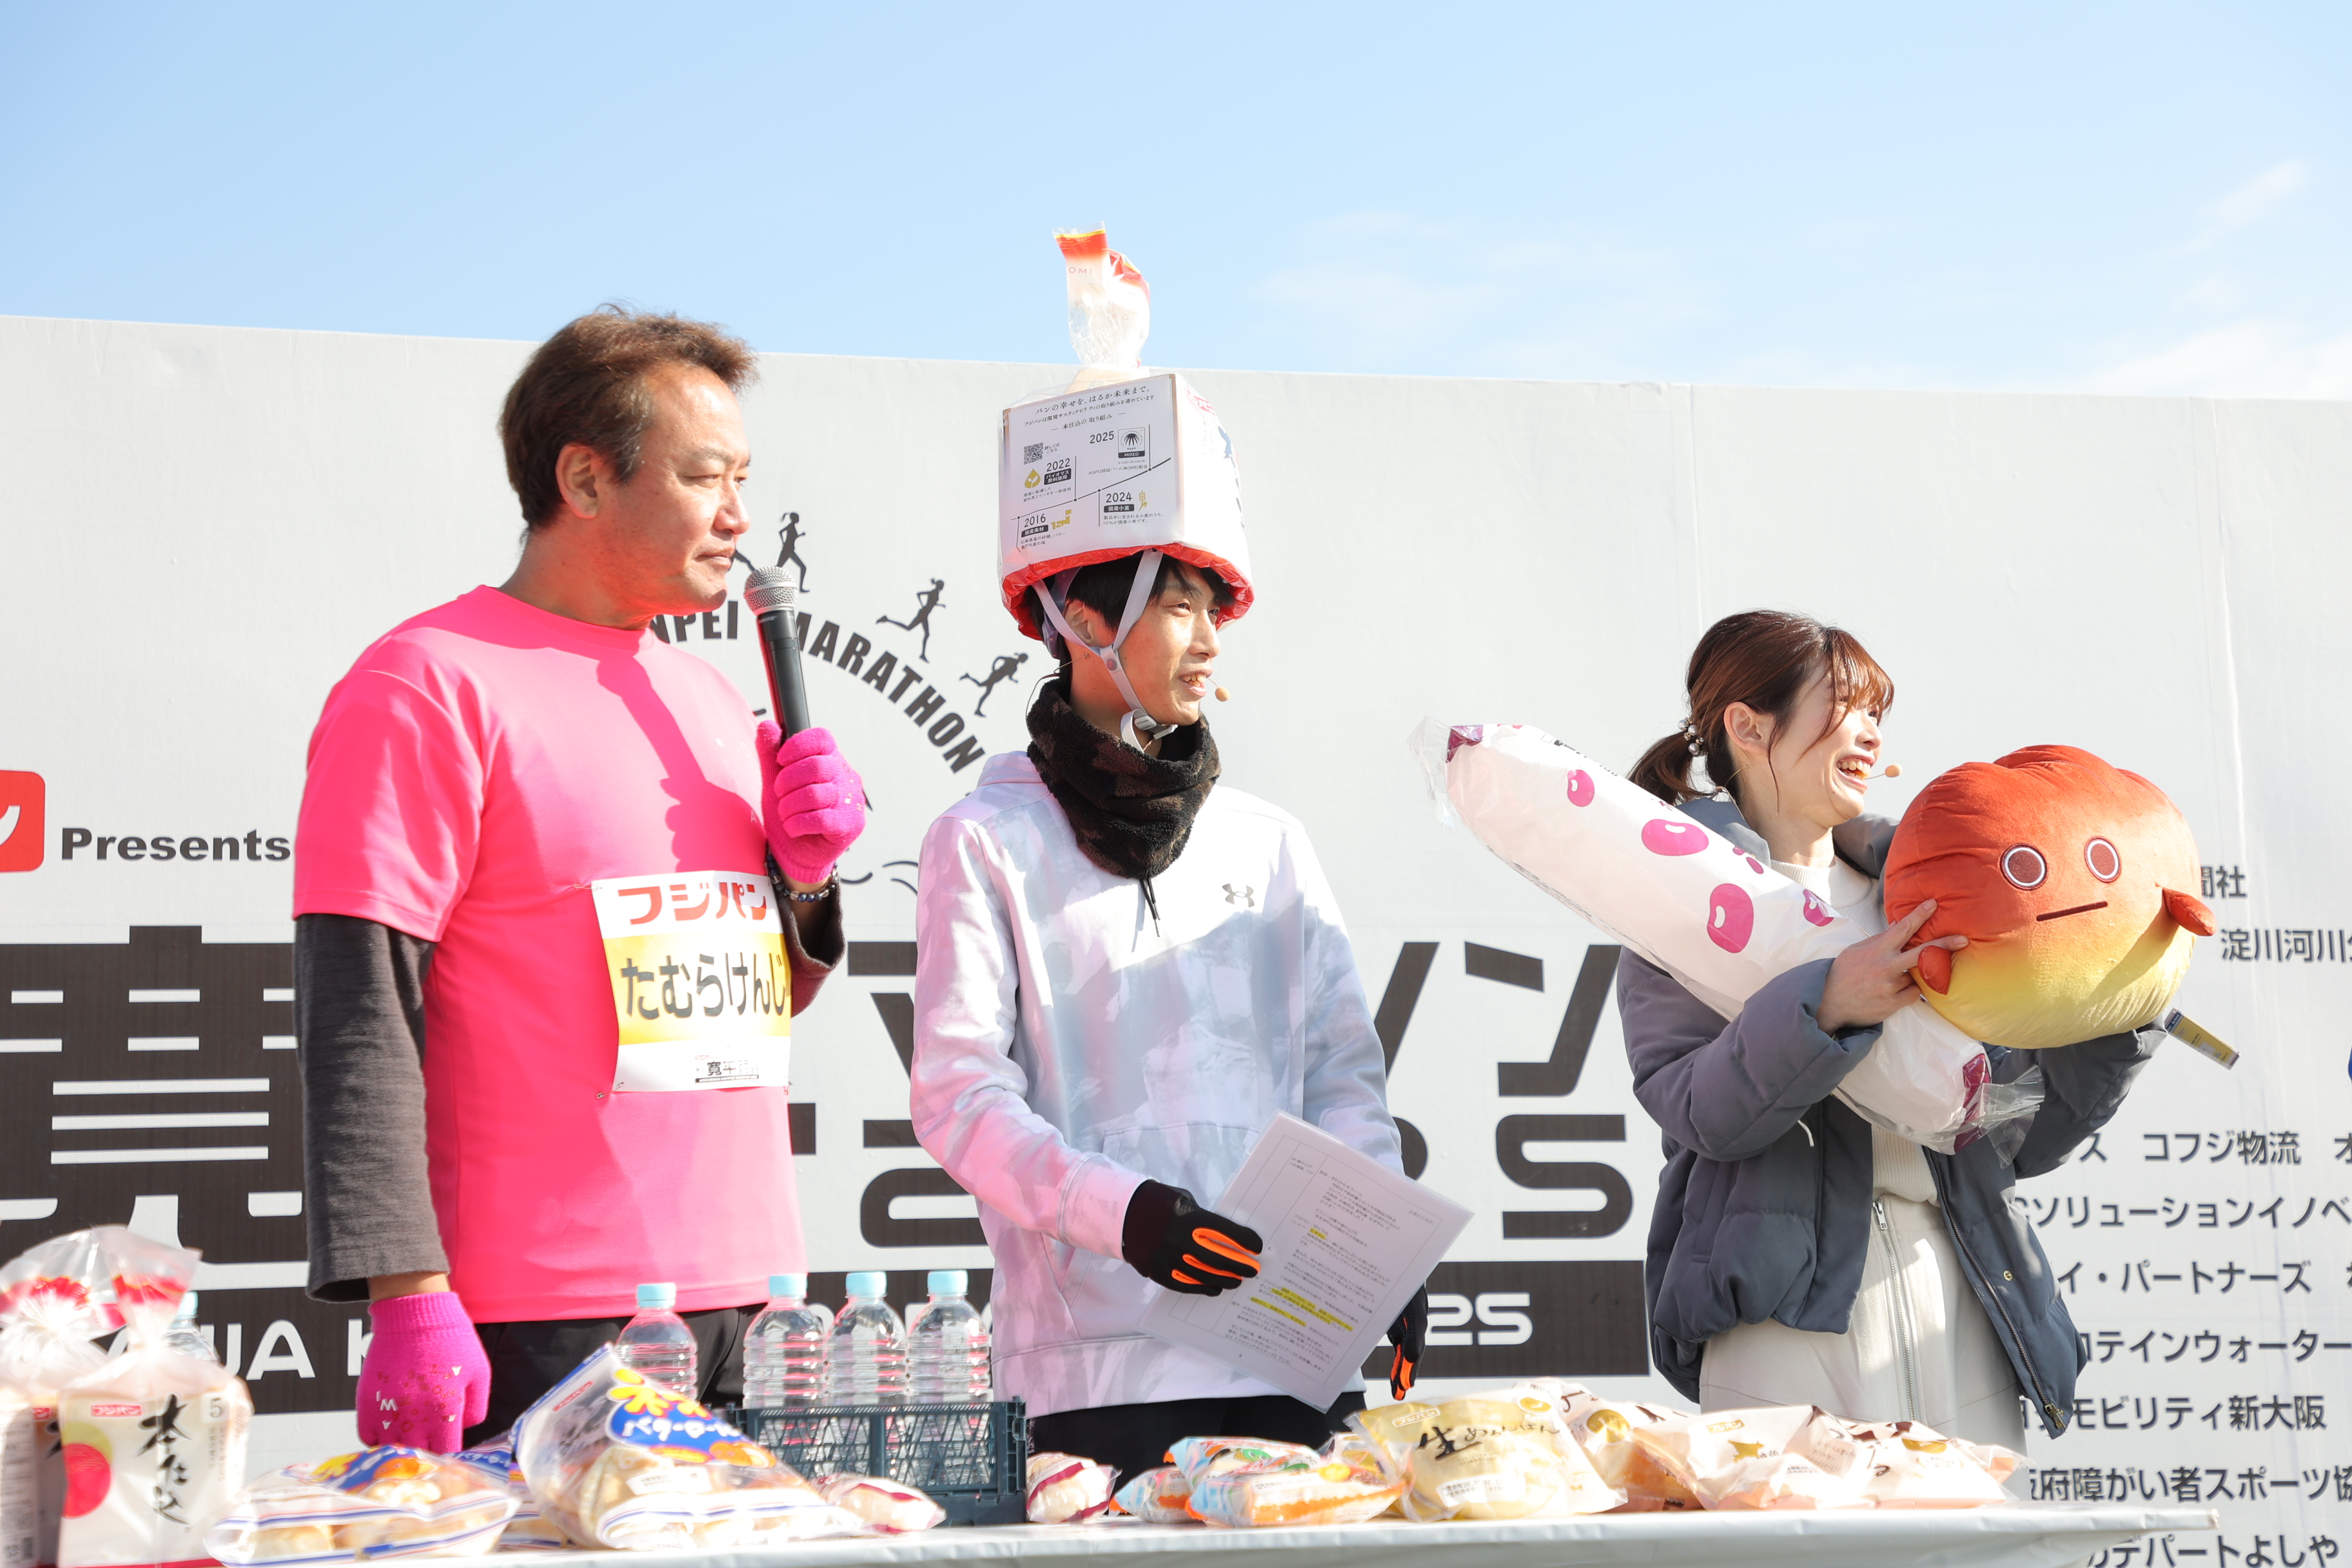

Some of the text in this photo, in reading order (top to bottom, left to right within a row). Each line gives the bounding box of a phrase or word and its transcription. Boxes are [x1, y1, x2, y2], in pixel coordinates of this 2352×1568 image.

[1035, 386, 1151, 414] パンの幸せを、はるか未来まで。
[1090, 431, 1114, 444] 2025
[1046, 458, 1070, 472] 2022
[1046, 471, 1070, 479] バイオマス
[1048, 475, 1068, 484] 原料使用
[1106, 491, 1132, 503] 2024
[1024, 513, 1046, 527] 2016
[1024, 527, 1044, 536] 国産素材
[61, 828, 291, 862] Presents
[617, 882, 767, 925] フジパン
[2220, 928, 2352, 963] 淀川河川
[620, 952, 786, 1021] たむらけんじ
[2143, 1130, 2302, 1166] コフジ物流
[2057, 1259, 2313, 1294] イ・パートナーズ
[1426, 1293, 1534, 1346] 25
[93, 1404, 142, 1416] フジパン
[210, 1398, 224, 1418] 5
[2023, 1395, 2328, 1431] モビリティ新大阪
[1395, 1410, 1438, 1426] フジパン
[1708, 1420, 1743, 1433] フジパン
